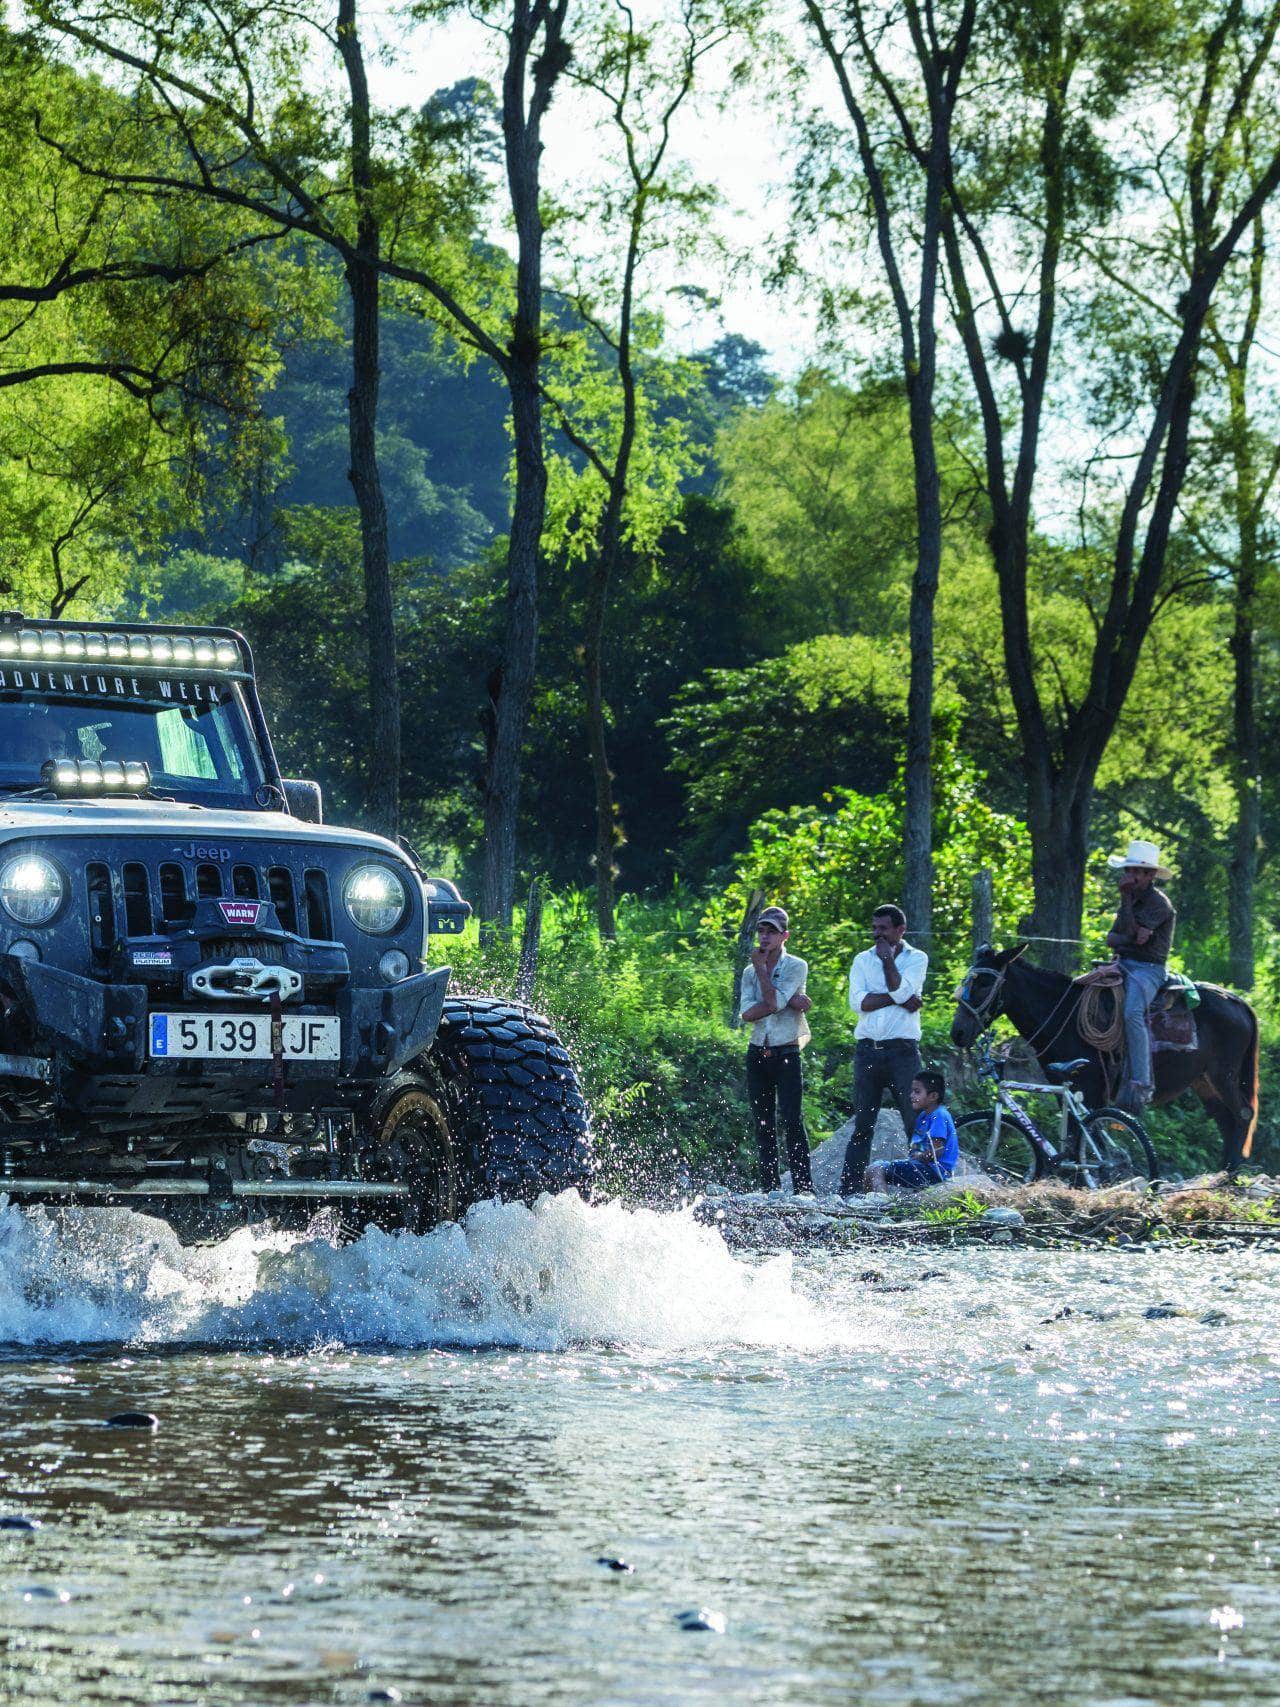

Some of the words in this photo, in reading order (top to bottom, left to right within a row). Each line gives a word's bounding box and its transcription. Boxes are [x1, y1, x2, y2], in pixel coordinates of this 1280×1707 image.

[158, 680, 220, 702] WEEK
[182, 842, 231, 863] Jeep
[226, 908, 255, 918] WARN
[156, 1039, 164, 1049] E
[180, 1019, 257, 1052] 5139
